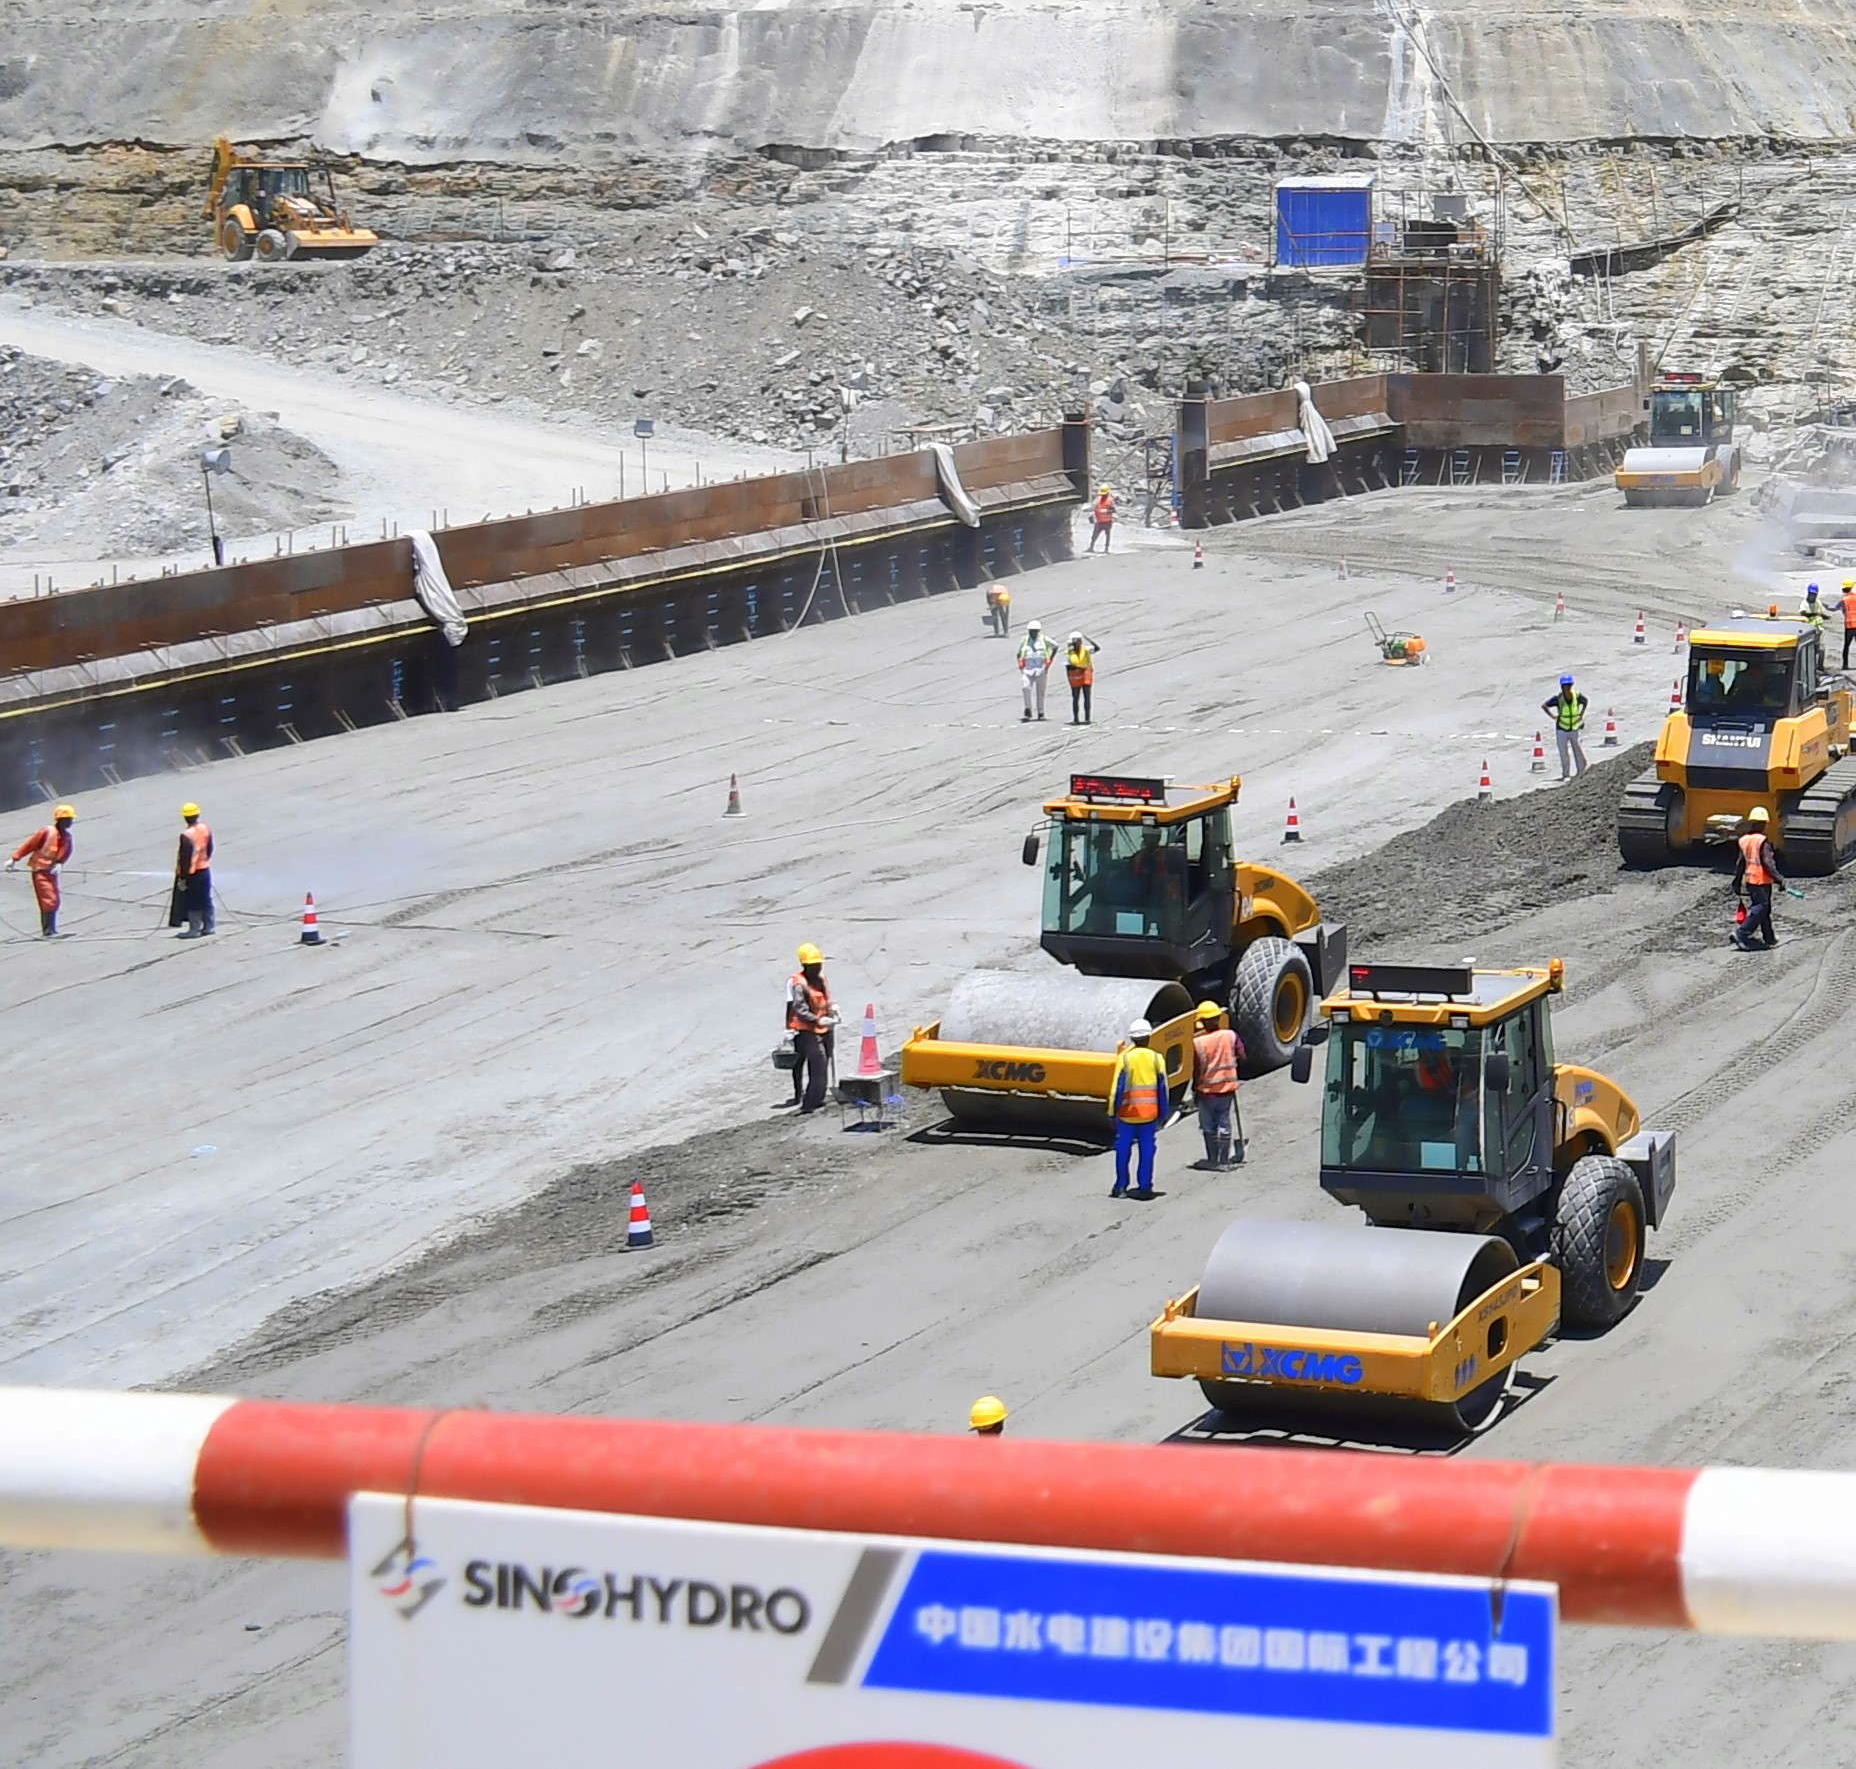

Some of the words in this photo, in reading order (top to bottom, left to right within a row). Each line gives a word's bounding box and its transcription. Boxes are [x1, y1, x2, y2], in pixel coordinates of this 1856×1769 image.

[971, 1059, 1047, 1083] XCMG
[1257, 1347, 1364, 1385] XCMG
[463, 1559, 811, 1635] SINOHYDRO
[916, 1604, 1529, 1686] 中国水电建设集团国际工程公司
